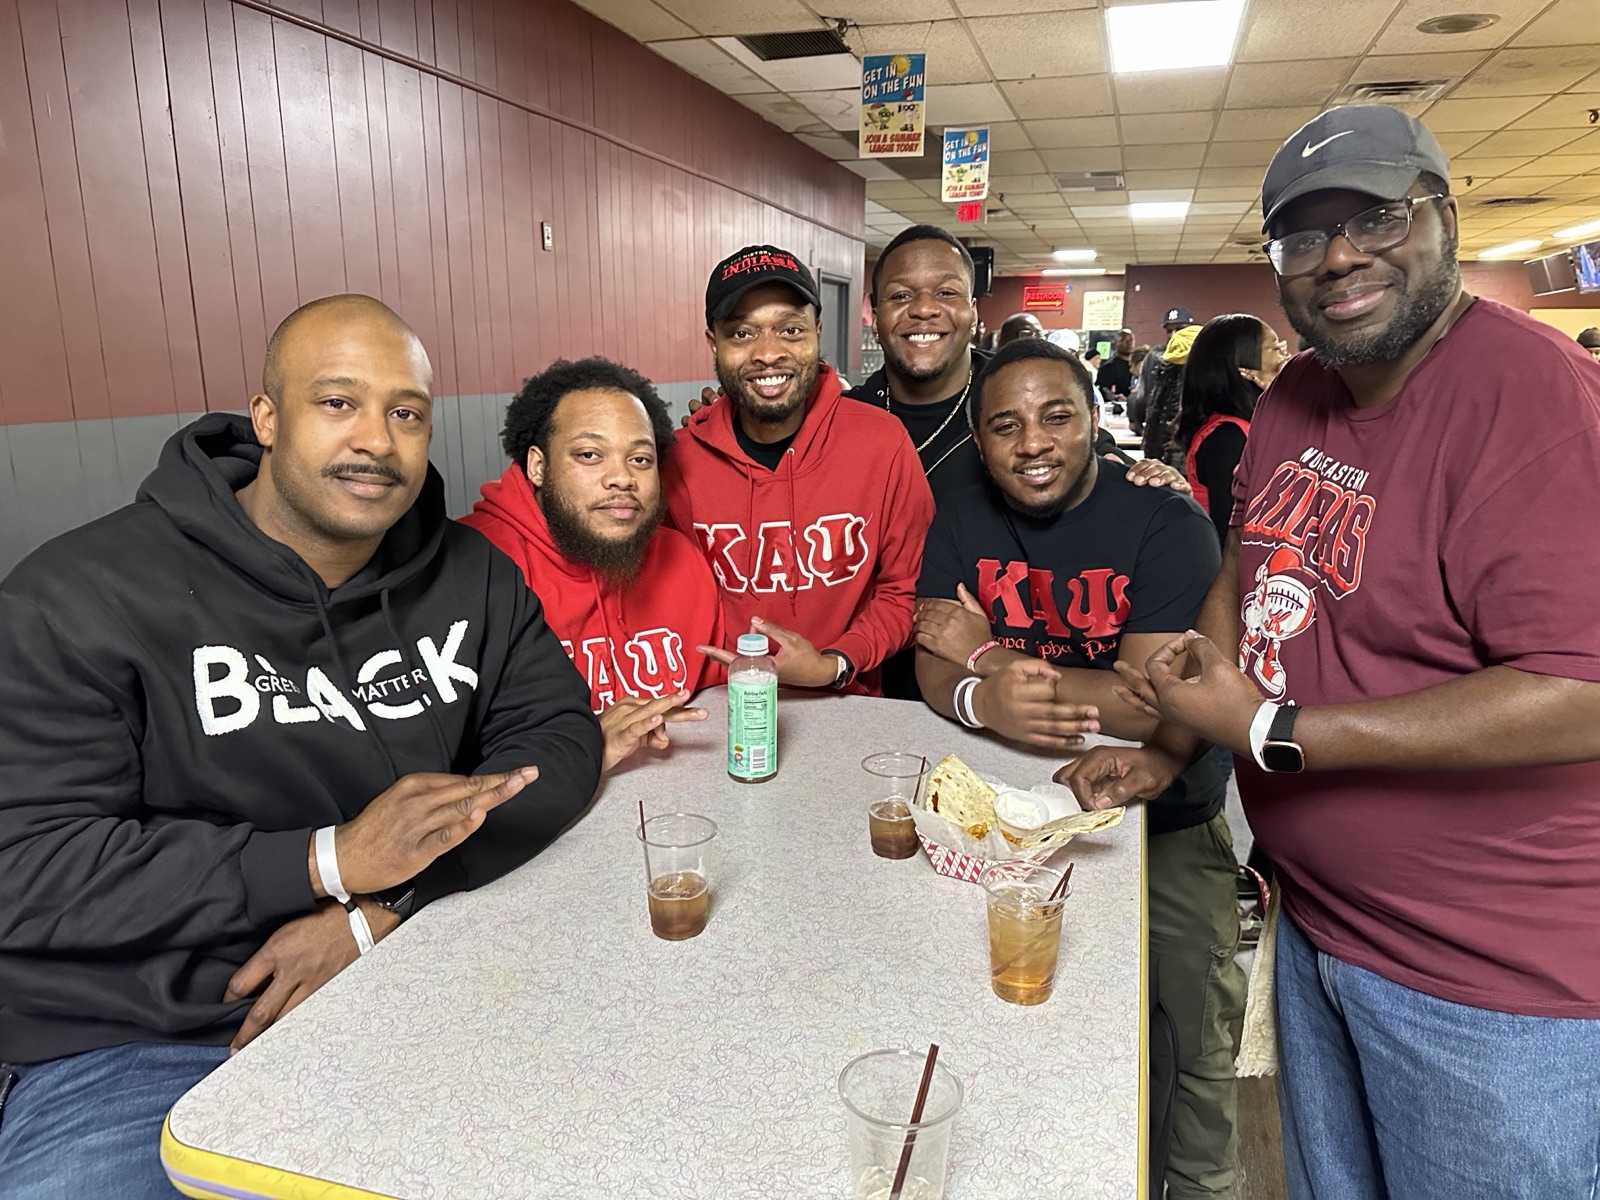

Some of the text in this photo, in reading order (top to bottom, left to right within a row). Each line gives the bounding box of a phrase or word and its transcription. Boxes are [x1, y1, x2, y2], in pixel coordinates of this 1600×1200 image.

[863, 63, 897, 84] GET IN
[863, 73, 923, 99] ON THE FUN
[864, 132, 922, 144] JOIN A SUMMER
[869, 143, 919, 153] LEAGUE TODAY
[945, 137, 969, 151] GET IN
[945, 143, 987, 162] ON THE FUN
[959, 202, 982, 222] EXIT
[722, 255, 799, 280] INDIANA
[351, 668, 428, 702] MATTER
